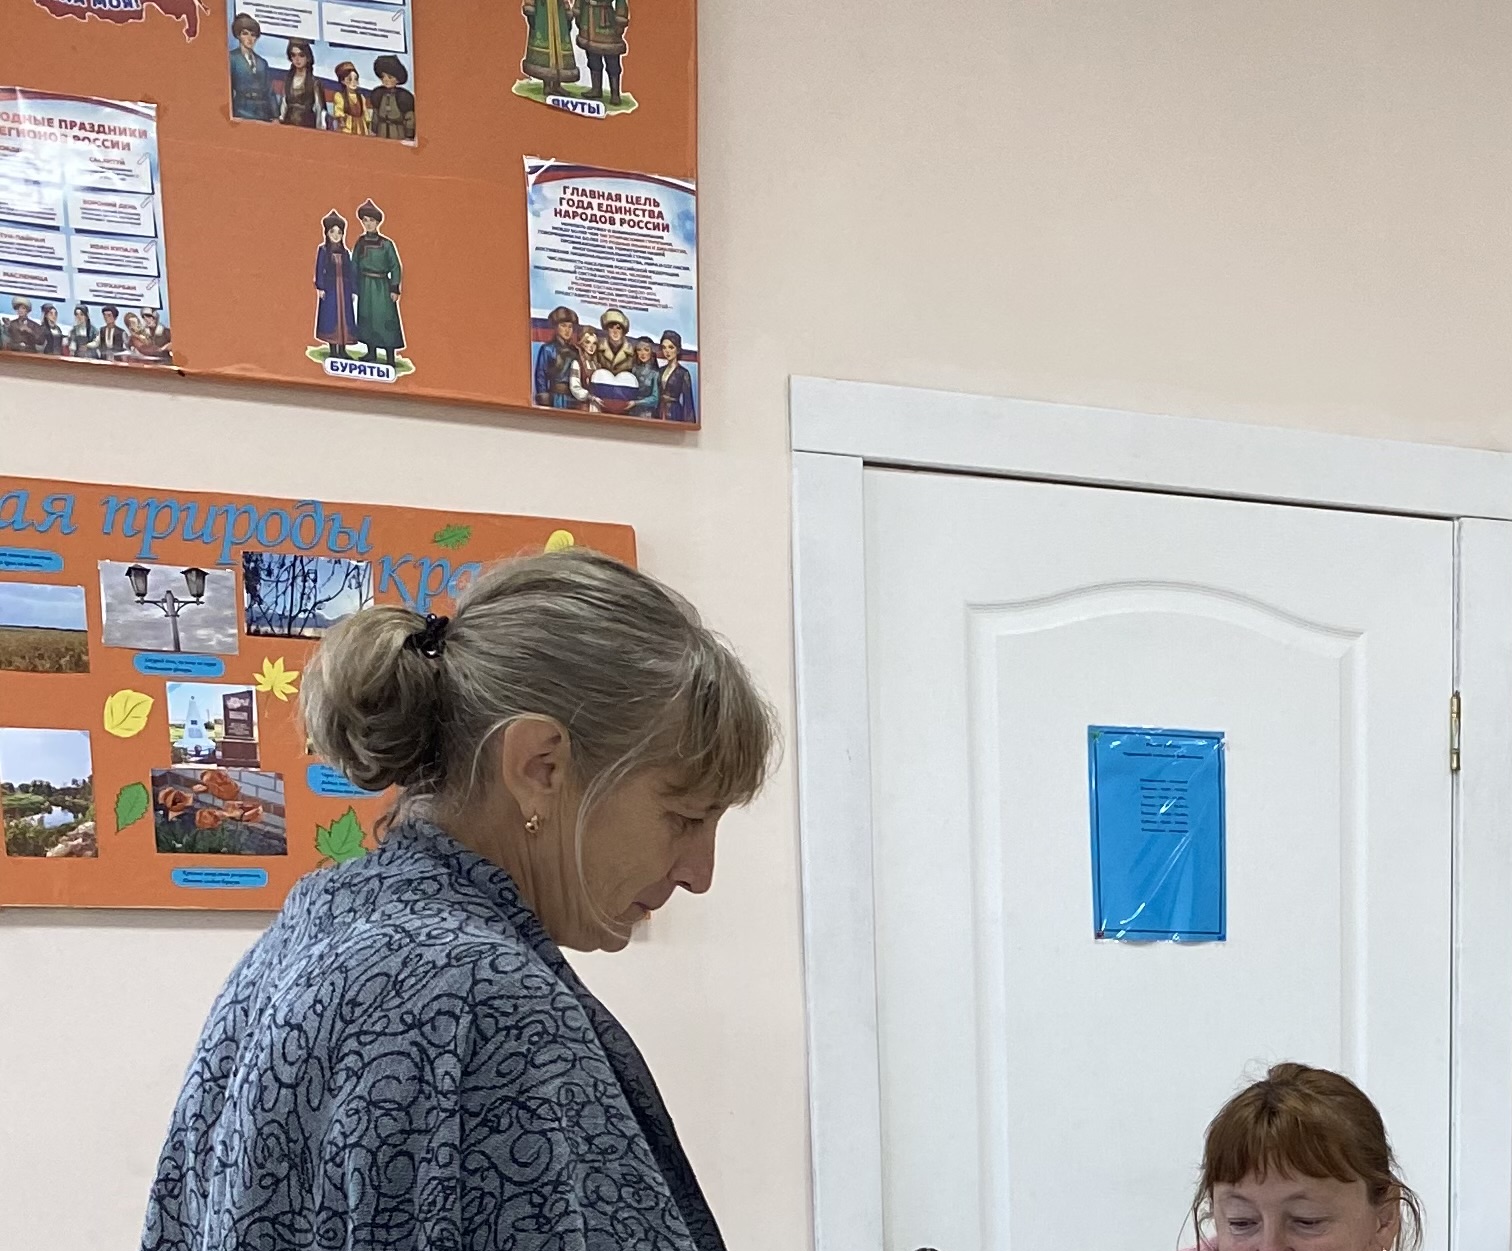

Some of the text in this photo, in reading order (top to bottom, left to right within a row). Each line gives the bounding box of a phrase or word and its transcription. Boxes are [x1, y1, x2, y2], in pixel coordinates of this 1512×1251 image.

[58, 118, 148, 139] ПРАЗДНИКИ
[559, 196, 665, 221] ГОДА ЕДИНСТВА
[562, 185, 661, 208] ГЛАВНАЯ ЦЕЛЬ
[554, 207, 670, 233] НАРОДОВ РОССИИ
[330, 360, 389, 379] БУРЯТЫ
[100, 496, 374, 566] природы
